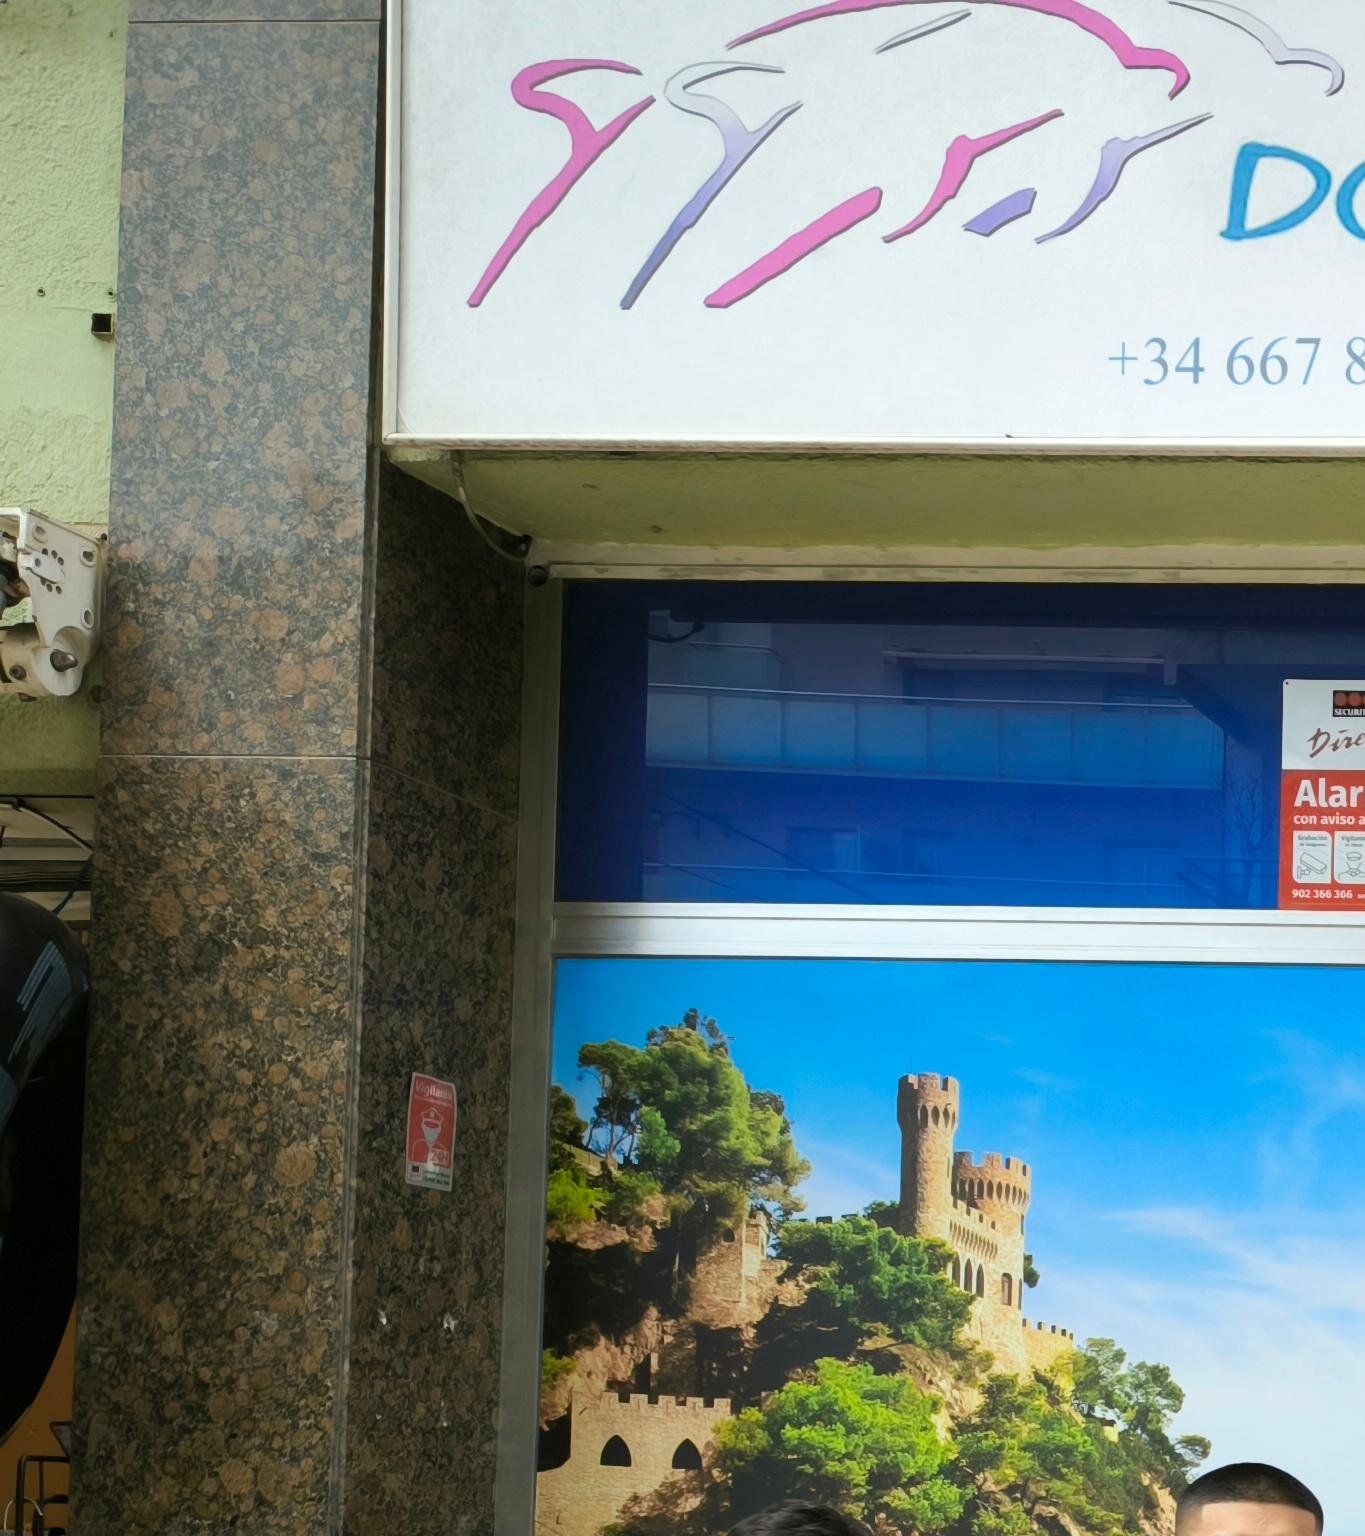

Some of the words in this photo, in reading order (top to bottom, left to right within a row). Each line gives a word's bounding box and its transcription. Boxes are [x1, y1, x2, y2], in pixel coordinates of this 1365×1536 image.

[1108, 335, 1205, 387] +34
[1225, 336, 1321, 386] 667
[1293, 814, 1317, 825] con
[1320, 812, 1356, 826] aviso
[1291, 888, 1311, 899] 902
[1313, 889, 1332, 899] 366
[1333, 889, 1353, 900] 366
